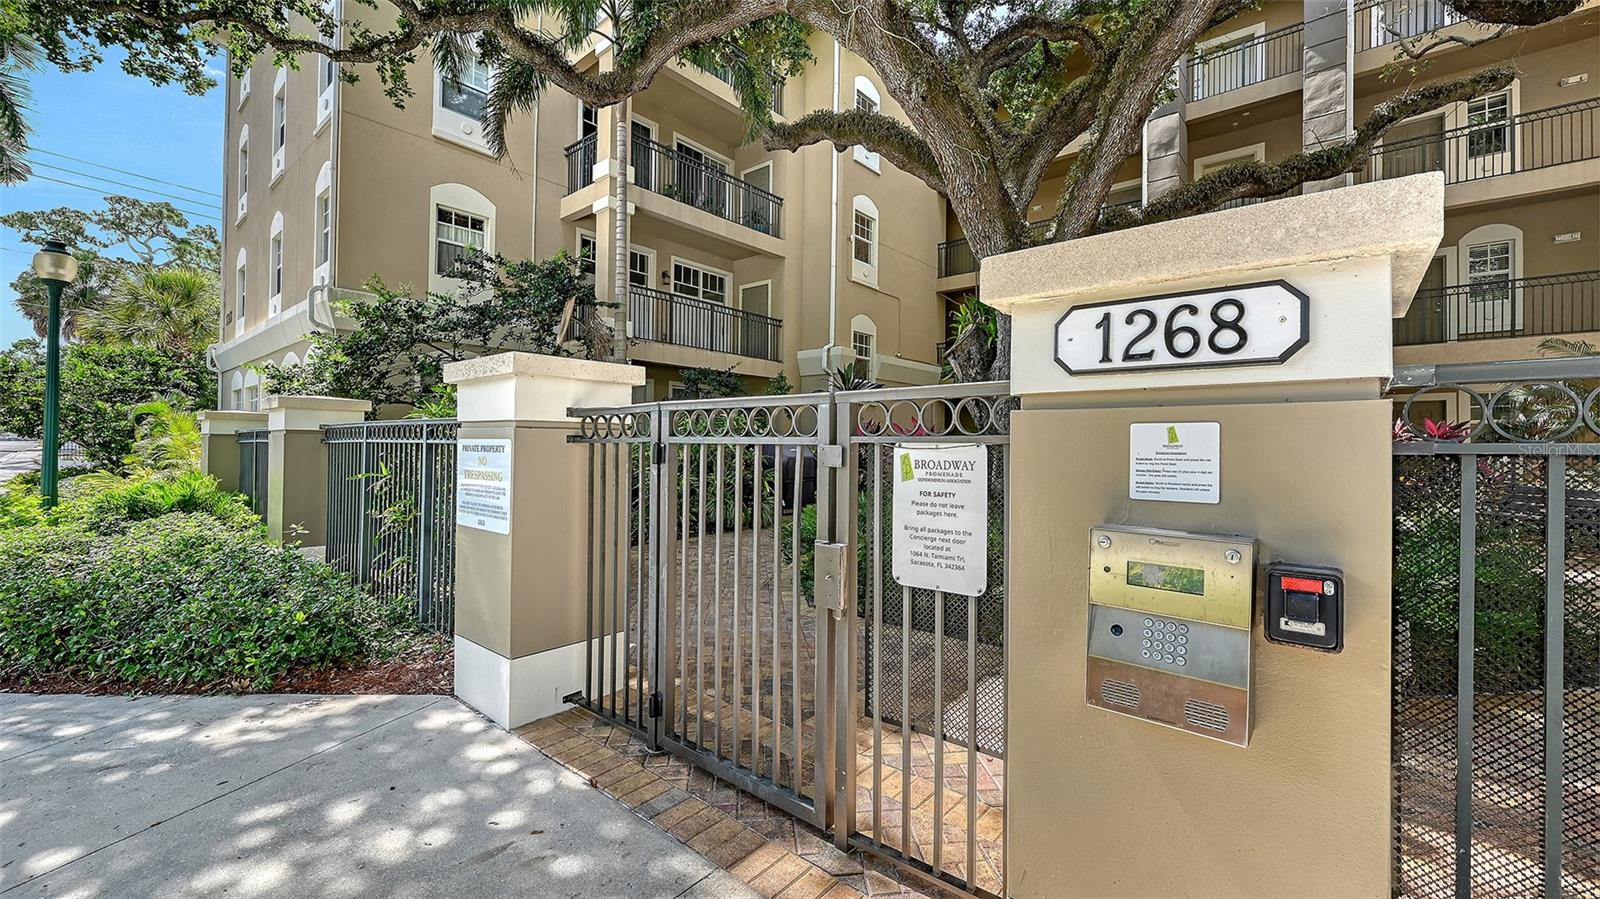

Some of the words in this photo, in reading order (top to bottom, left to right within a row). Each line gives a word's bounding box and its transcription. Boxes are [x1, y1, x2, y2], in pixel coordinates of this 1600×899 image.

[1095, 298, 1248, 363] 1268
[462, 444, 480, 452] PRIVATE
[481, 445, 505, 453] PROPERTY
[478, 456, 487, 465] NO
[914, 459, 976, 471] BROADWAY
[464, 469, 503, 482] TRESPASSING
[911, 500, 928, 508] Please
[916, 510, 942, 518] packages
[927, 527, 954, 536] packages
[909, 533, 937, 543] Concierge
[923, 543, 944, 552] located
[931, 553, 955, 561] Tamiami
[910, 558, 935, 568] Sarasota,
[944, 563, 965, 571] 342364
